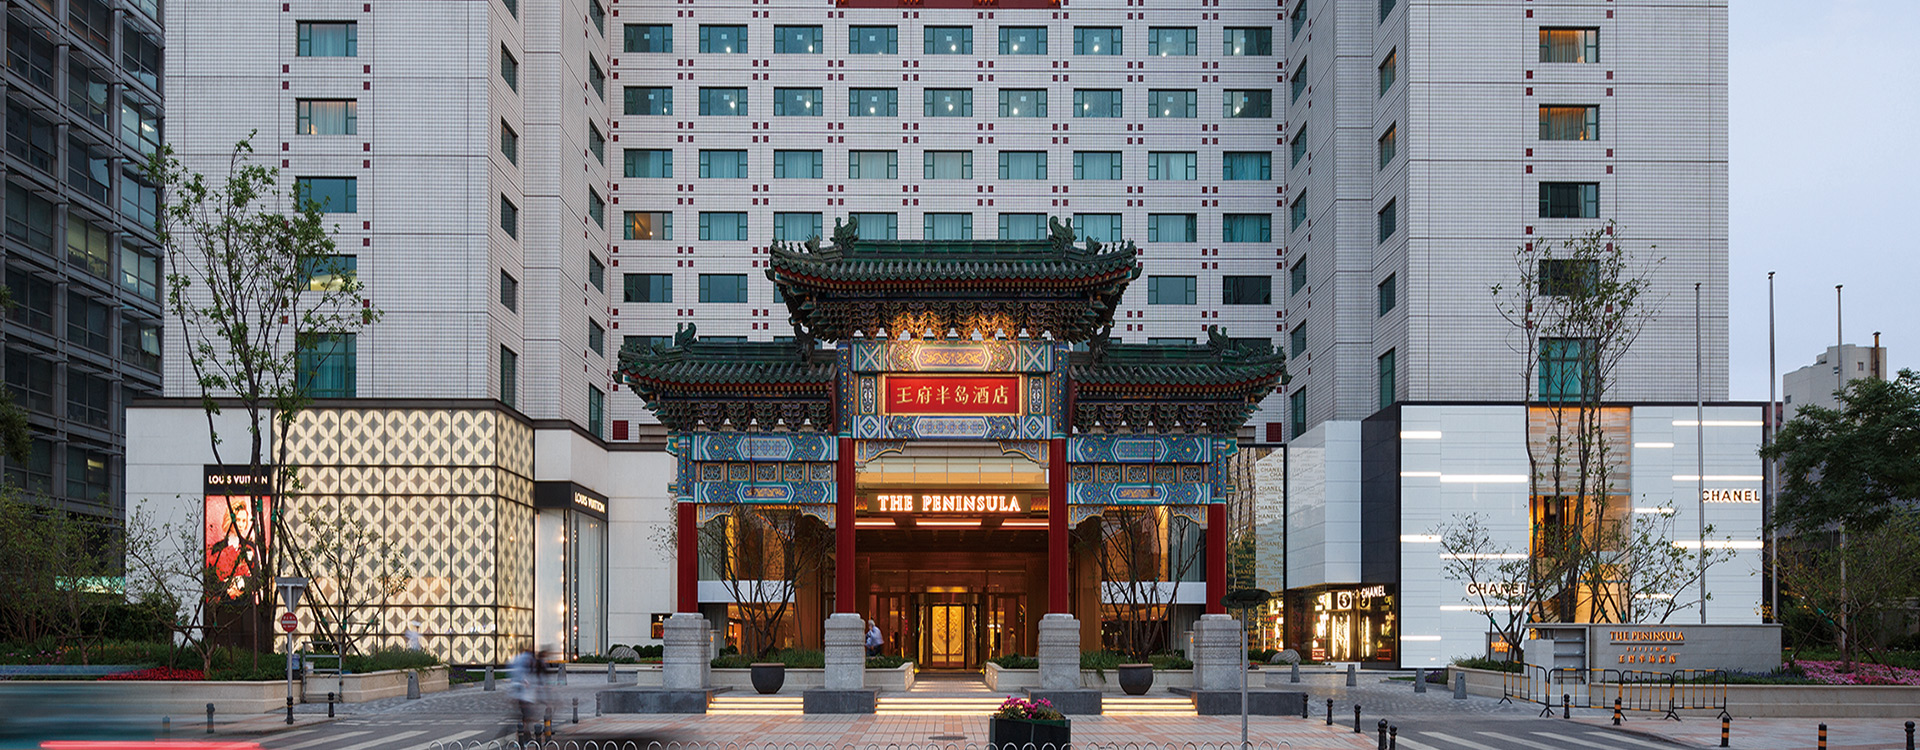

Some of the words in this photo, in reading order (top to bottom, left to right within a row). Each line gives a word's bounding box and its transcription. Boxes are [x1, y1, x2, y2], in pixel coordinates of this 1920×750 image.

[896, 385, 1009, 405] 王府半岛酒店
[208, 475, 232, 484] LOUS
[575, 492, 588, 507] LOUIS
[1702, 490, 1760, 502] CHANEL
[877, 495, 913, 511] THE
[922, 495, 1021, 511] PENINSULA
[1361, 585, 1386, 598] CHANEL
[1610, 631, 1630, 641] THE
[1631, 631, 1685, 642] PENINSULA
